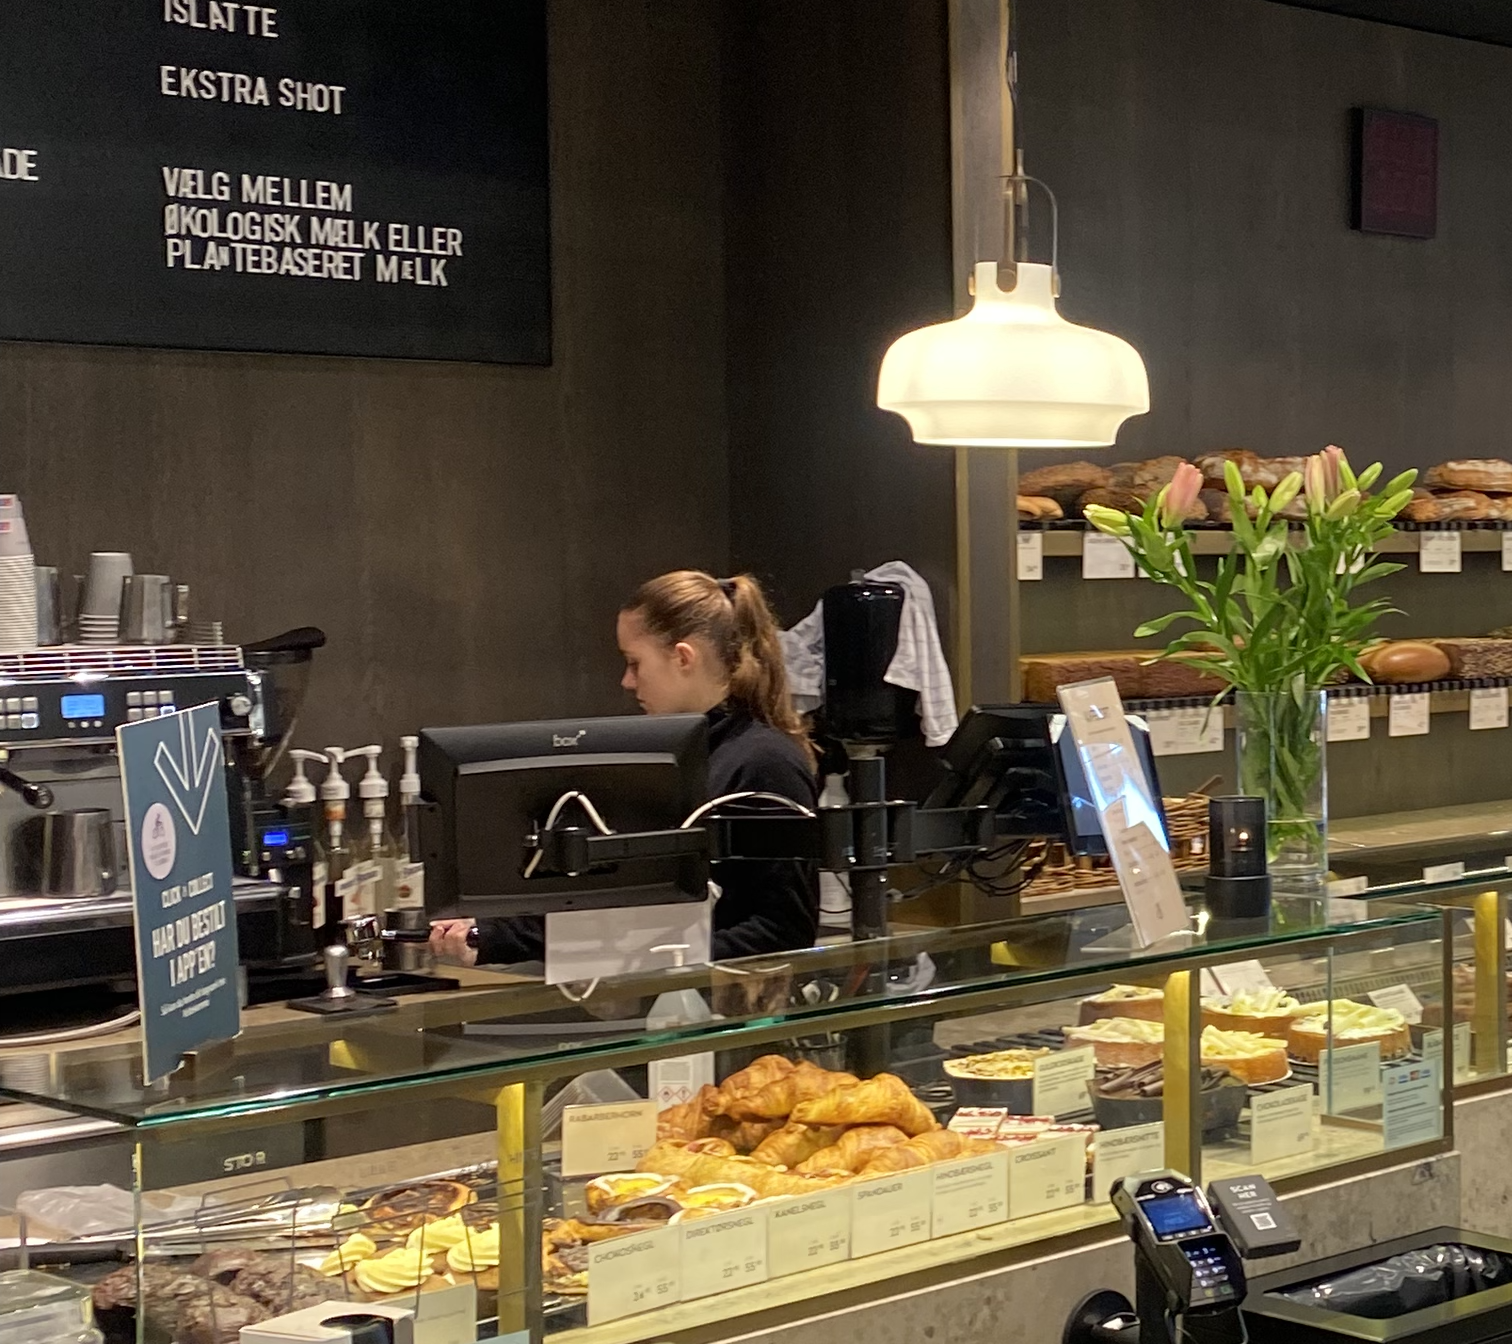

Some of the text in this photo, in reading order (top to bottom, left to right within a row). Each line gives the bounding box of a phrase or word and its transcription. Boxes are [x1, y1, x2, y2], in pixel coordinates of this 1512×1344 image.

[161, 66, 346, 115] EKSTRA SHOT
[0, 148, 39, 183] DE
[162, 166, 352, 212] VÆLG MELLEM
[164, 204, 463, 256] ØKOLOGISK MÆLK ELLER
[167, 239, 448, 287] PLANTEBASERET MÆLK
[152, 900, 226, 958] HAR DU BESTILT
